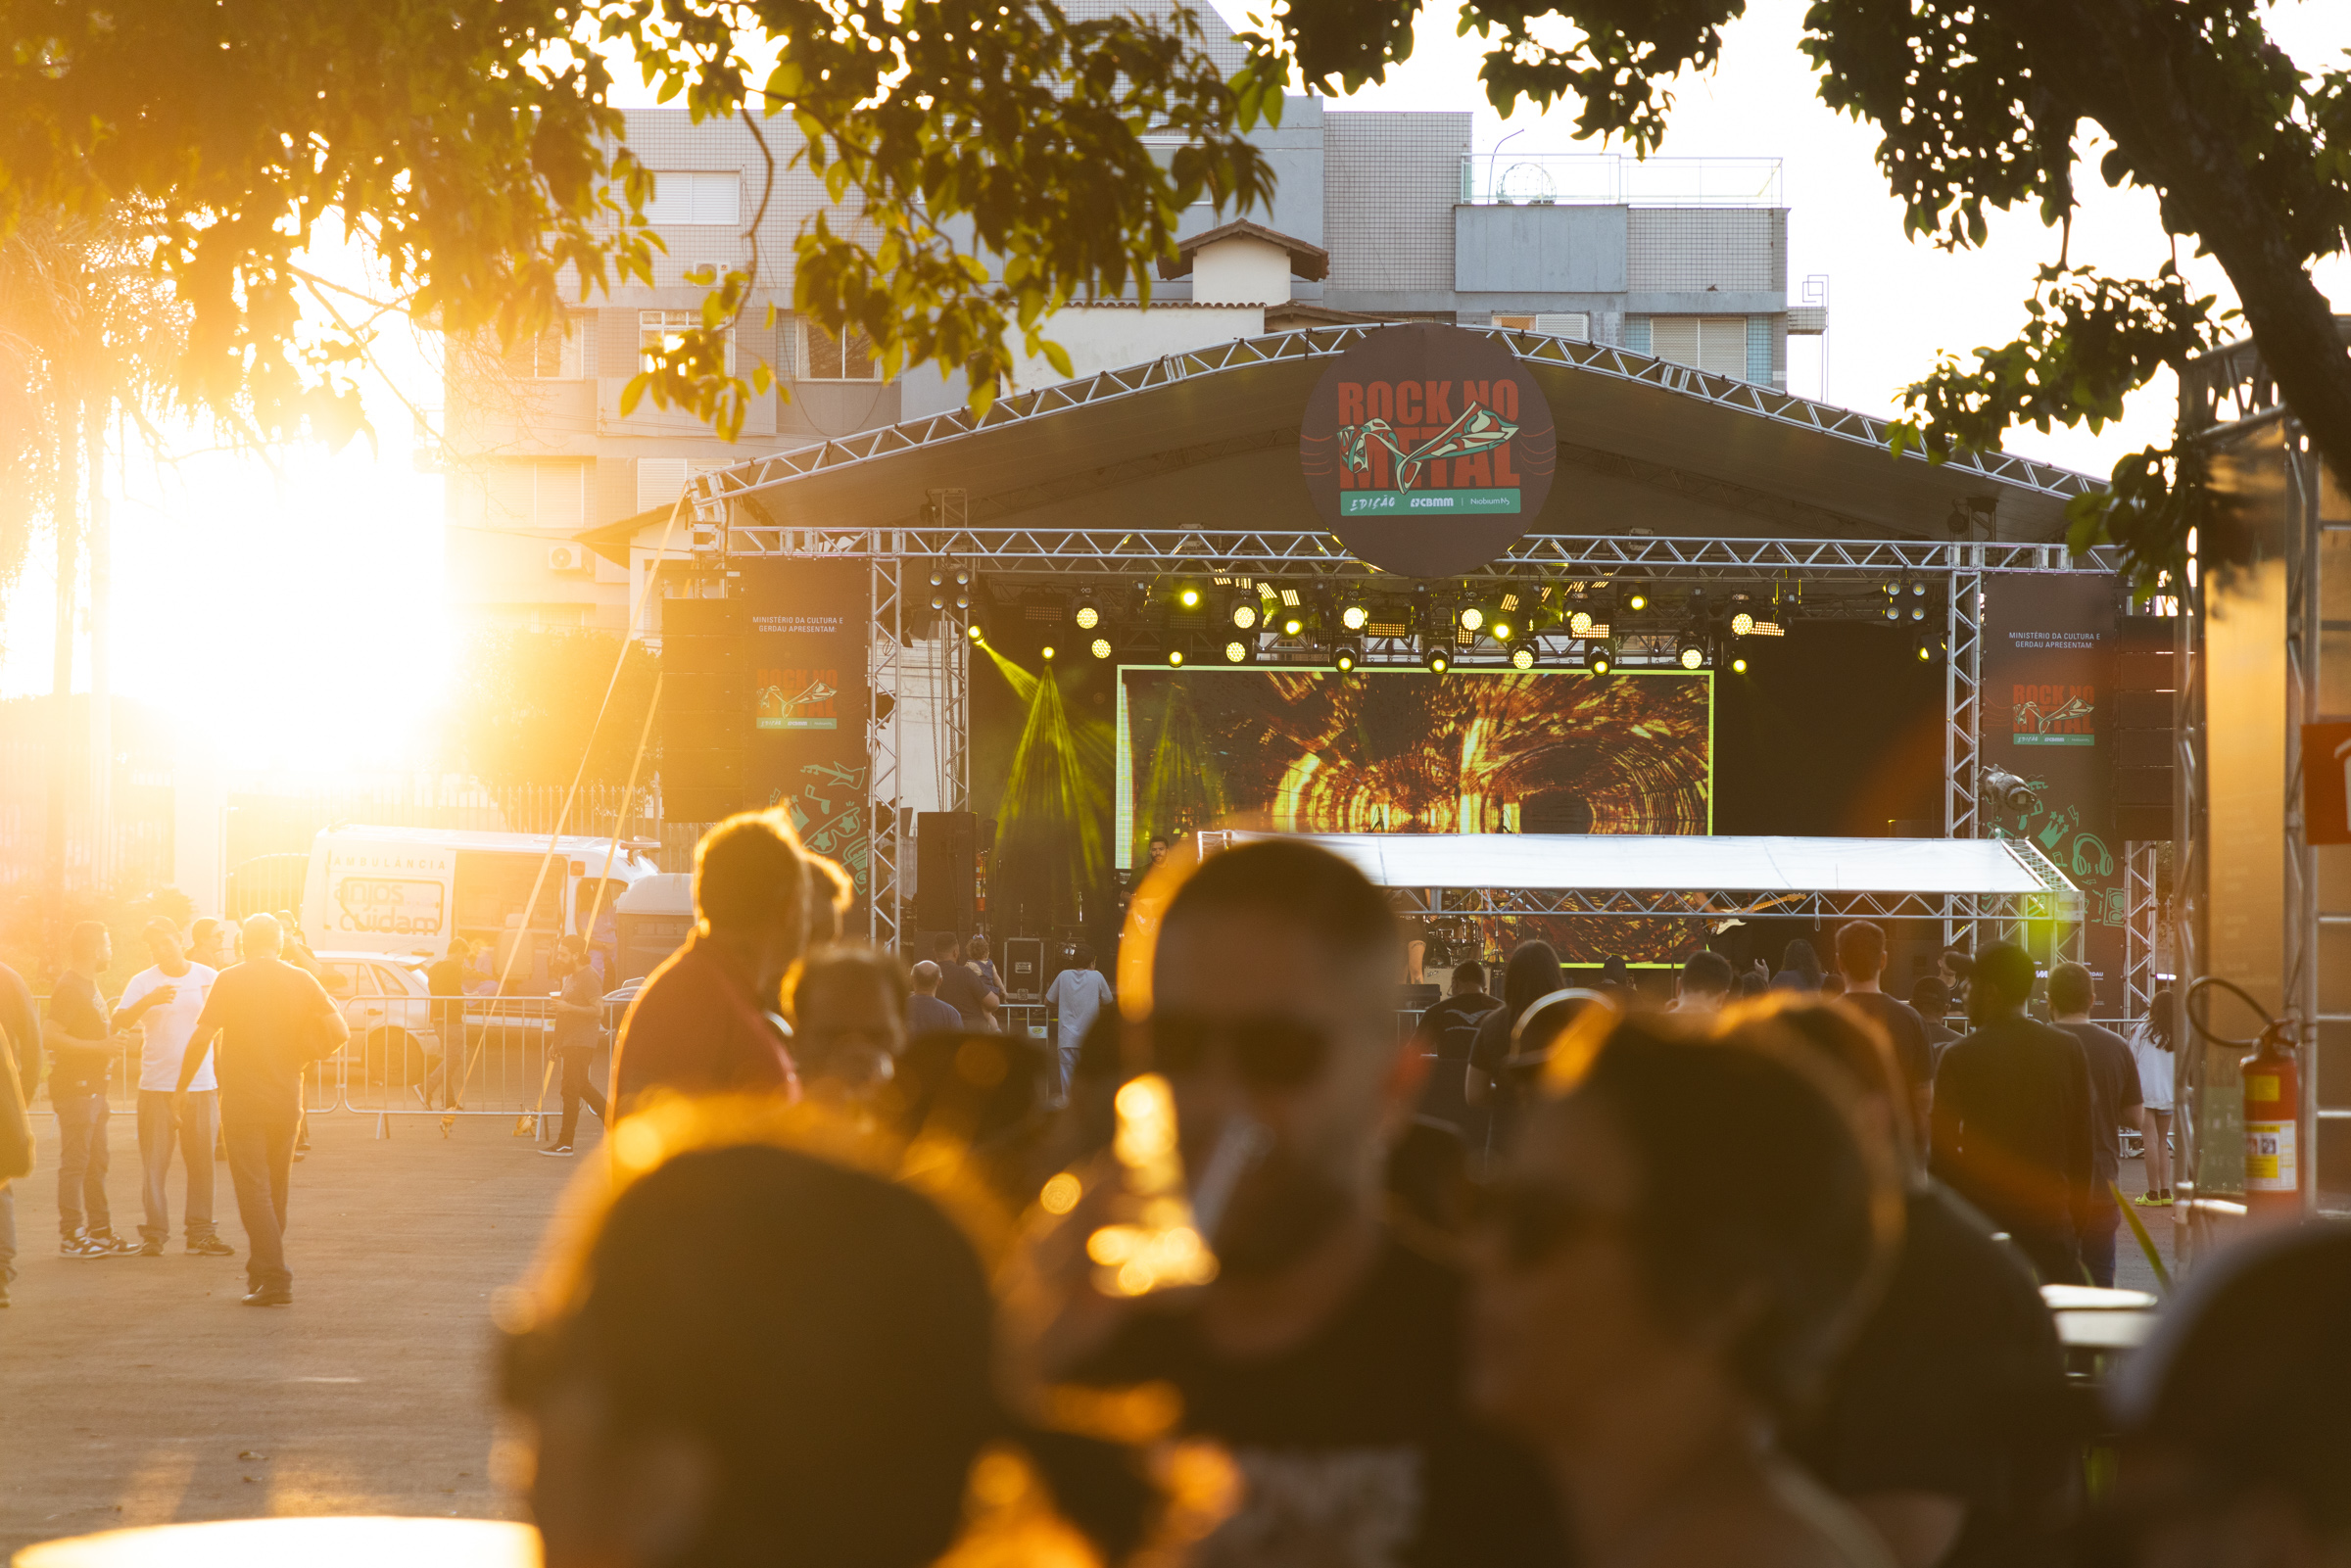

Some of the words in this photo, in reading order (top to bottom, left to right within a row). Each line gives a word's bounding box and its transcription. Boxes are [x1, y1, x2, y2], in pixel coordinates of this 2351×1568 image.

[1338, 380, 1454, 426] ROCK
[1463, 378, 1519, 422] NO
[1350, 495, 1396, 511] EDIÇÃO
[2009, 631, 2050, 640] MINISTÉRIO
[756, 668, 808, 689] ROCK
[813, 669, 838, 689] NO
[2013, 684, 2065, 706] ROCK
[2069, 685, 2094, 705] NO
[334, 854, 447, 871] AMBULÂNCIA
